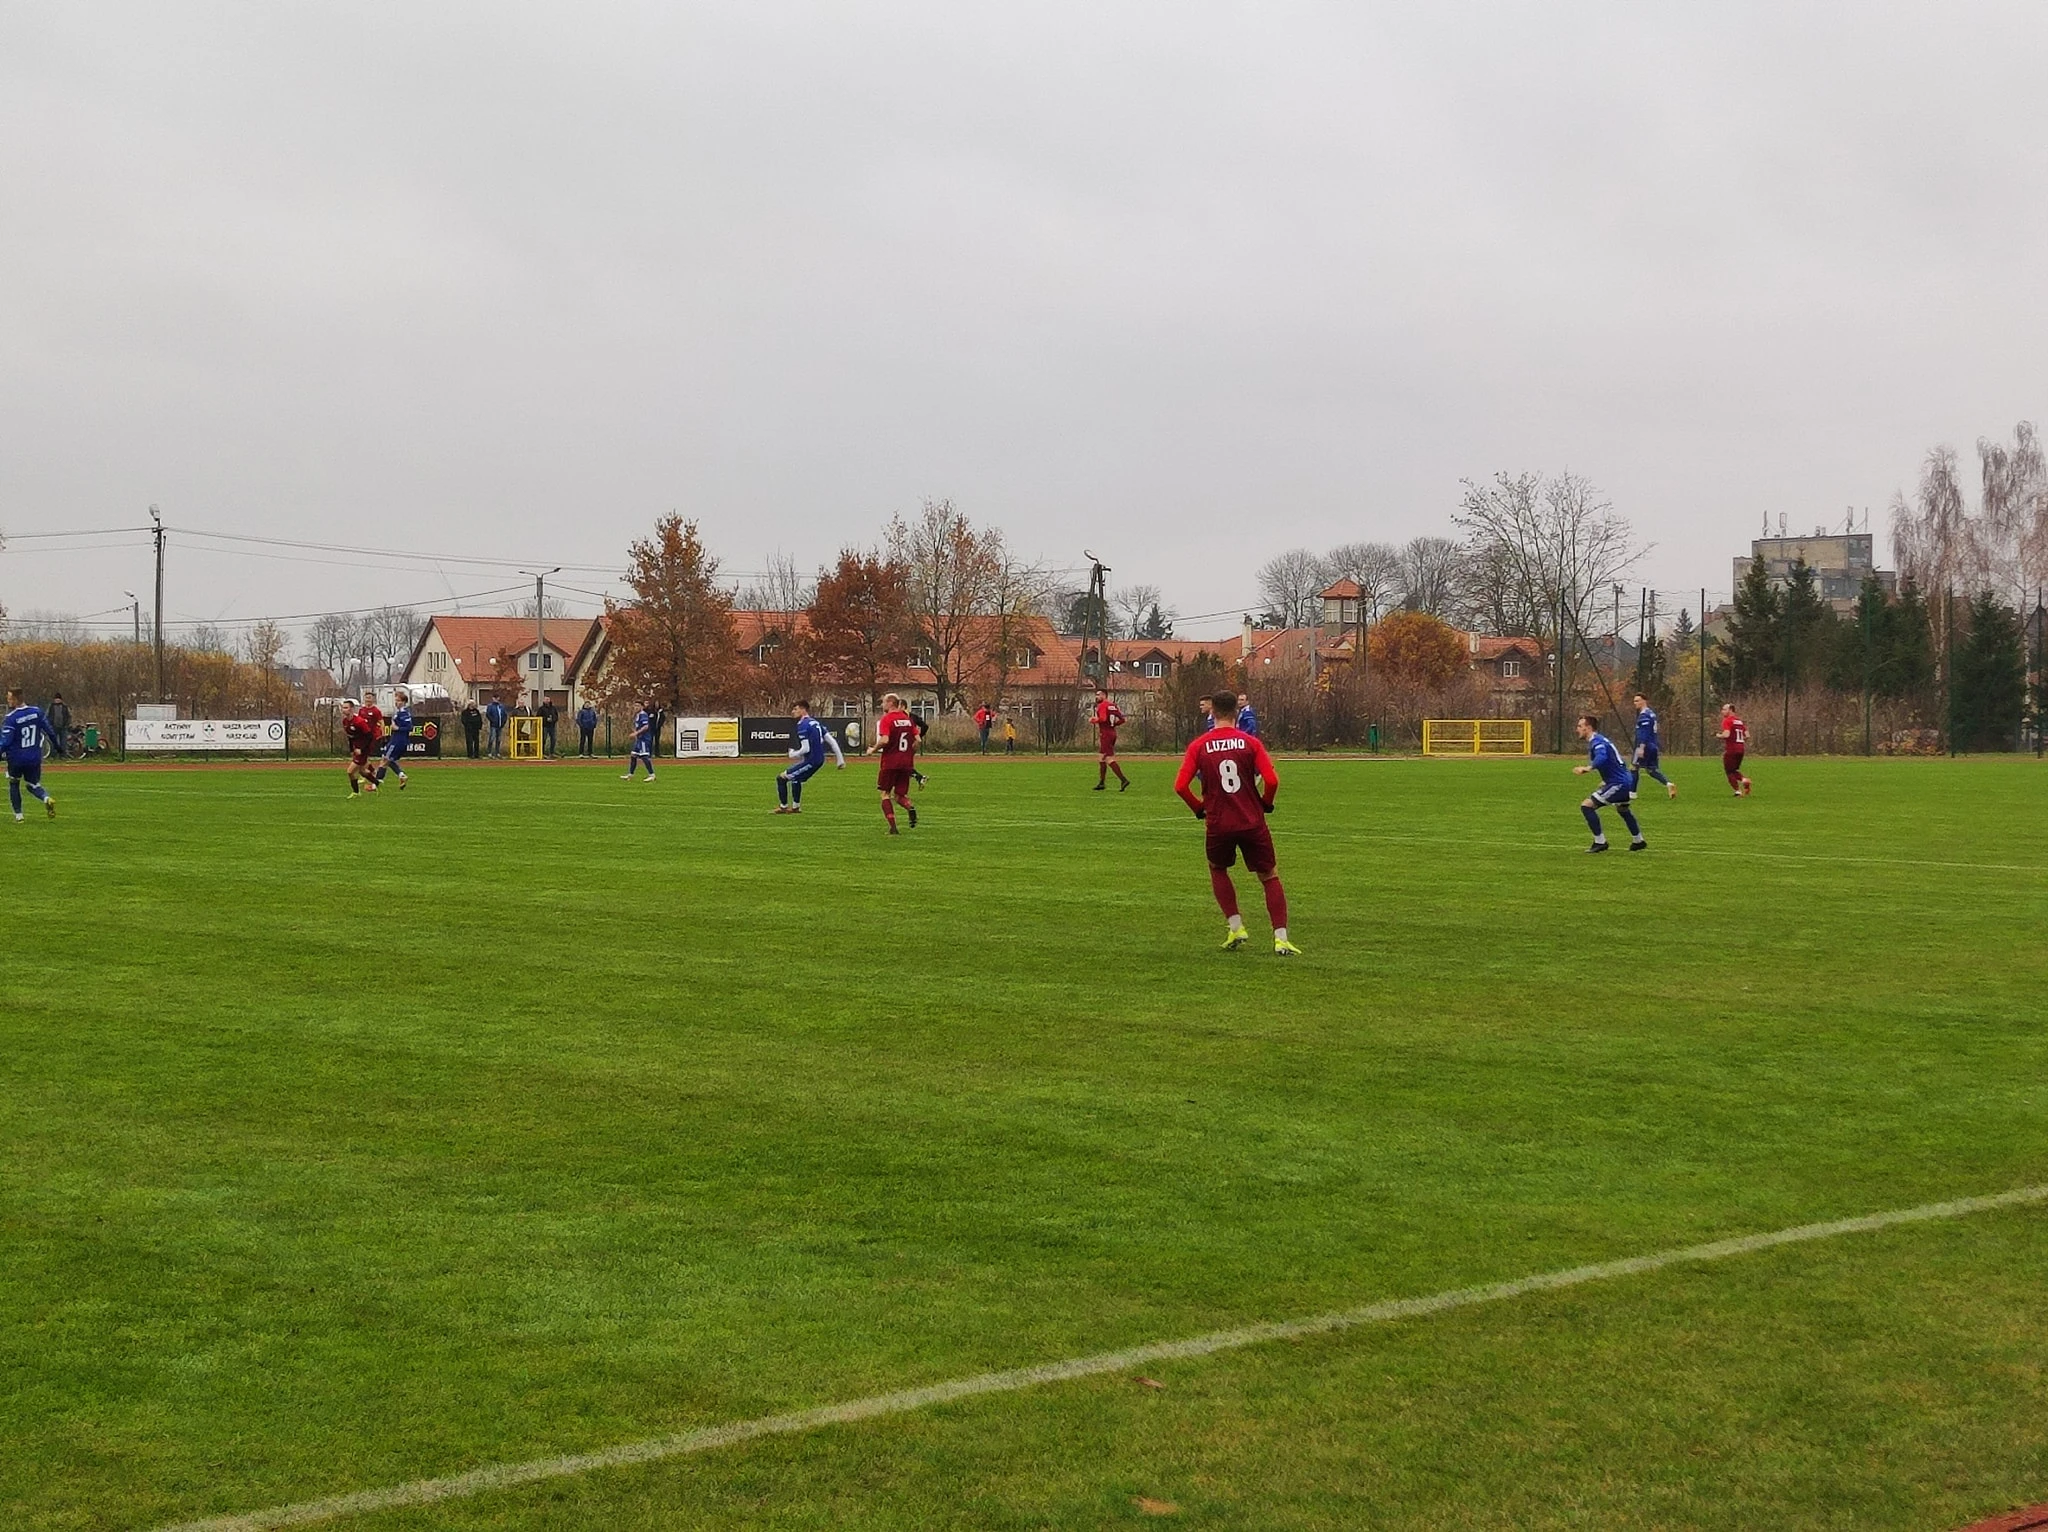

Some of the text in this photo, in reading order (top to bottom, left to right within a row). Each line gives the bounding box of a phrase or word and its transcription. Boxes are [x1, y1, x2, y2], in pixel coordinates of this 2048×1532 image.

[21, 724, 37, 748] 27
[898, 732, 908, 752] 6
[1205, 738, 1246, 754] LUZINO
[1219, 759, 1241, 794] 8
